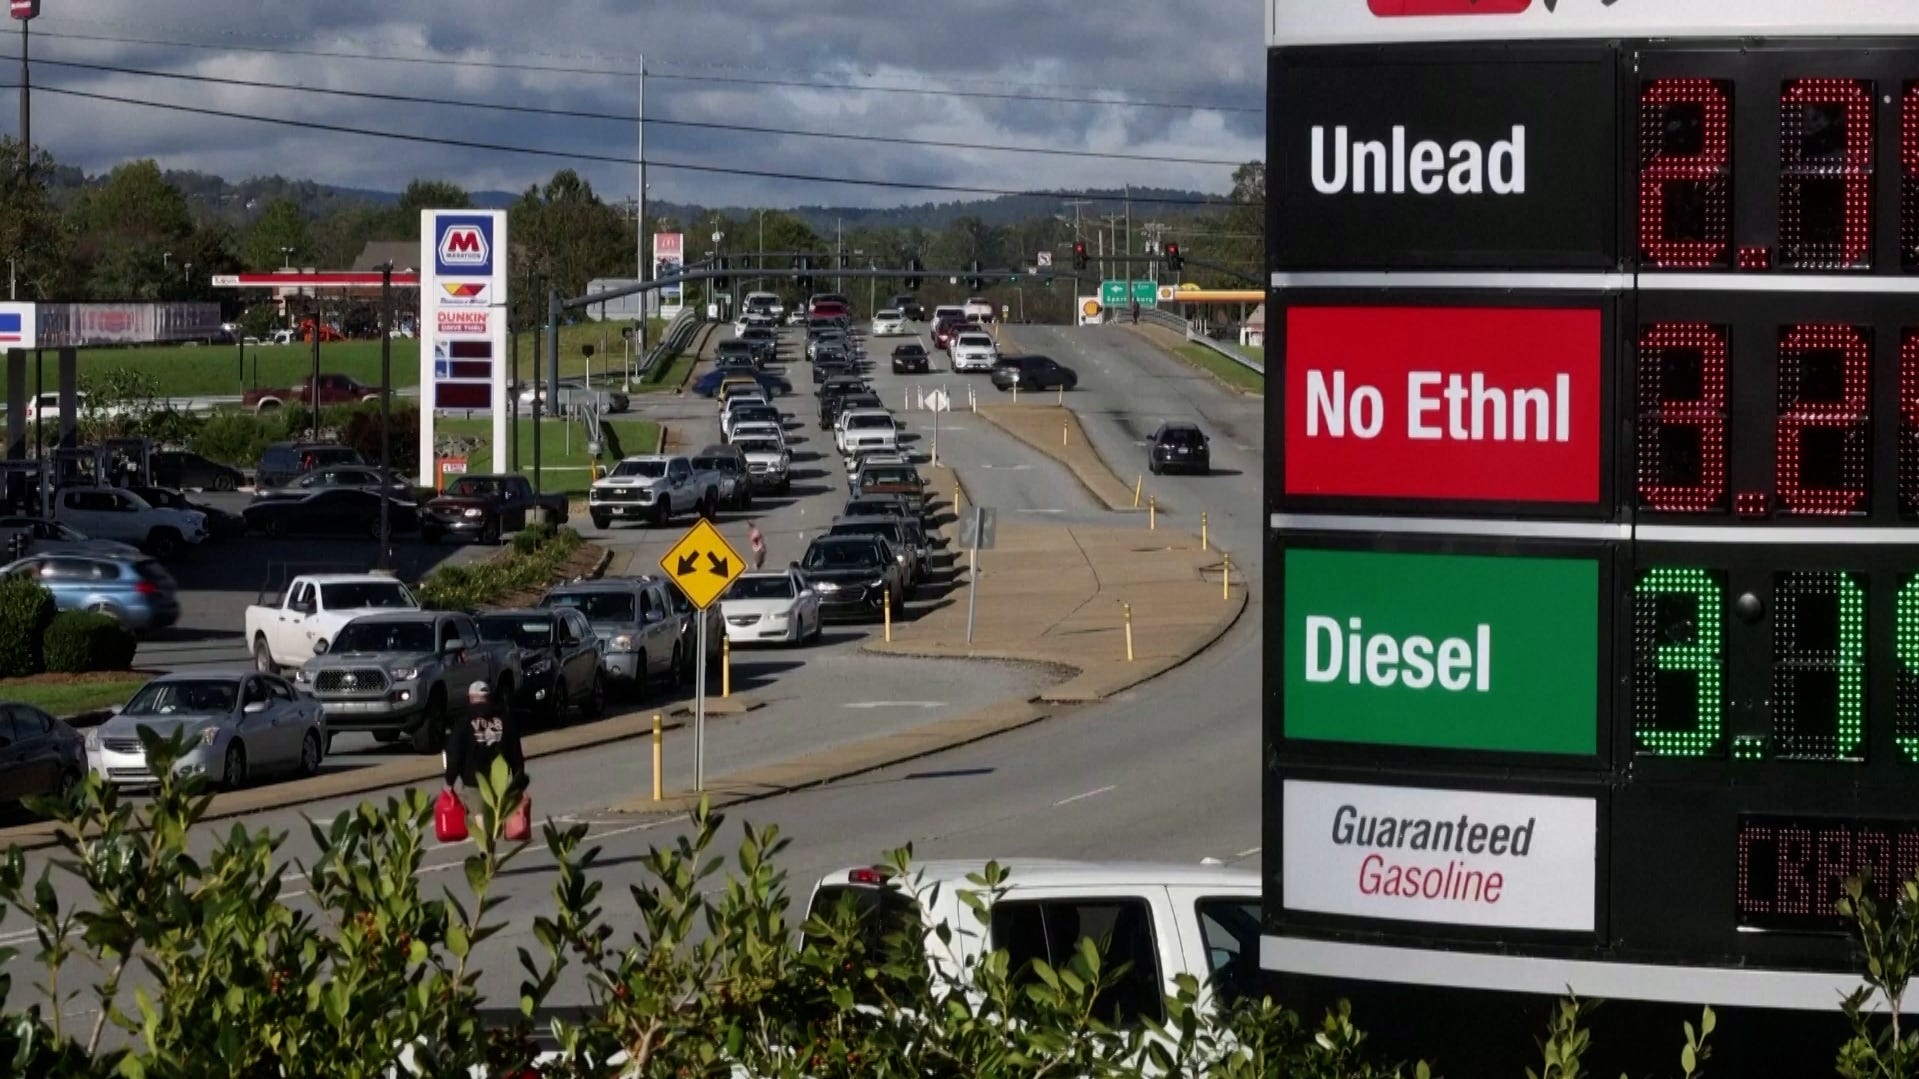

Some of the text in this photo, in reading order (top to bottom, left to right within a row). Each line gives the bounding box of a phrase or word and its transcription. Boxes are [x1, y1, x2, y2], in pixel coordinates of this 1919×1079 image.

[1311, 124, 1526, 195] Unlead
[1641, 78, 1919, 268] 2.7
[1306, 370, 1570, 442] No Ethnl
[1638, 323, 1919, 514] 3.2
[1305, 615, 1491, 692] Diesel
[1634, 569, 1919, 762] 3.1
[1332, 804, 1536, 857] Guaranteed
[1358, 854, 1504, 903] Gasoline
